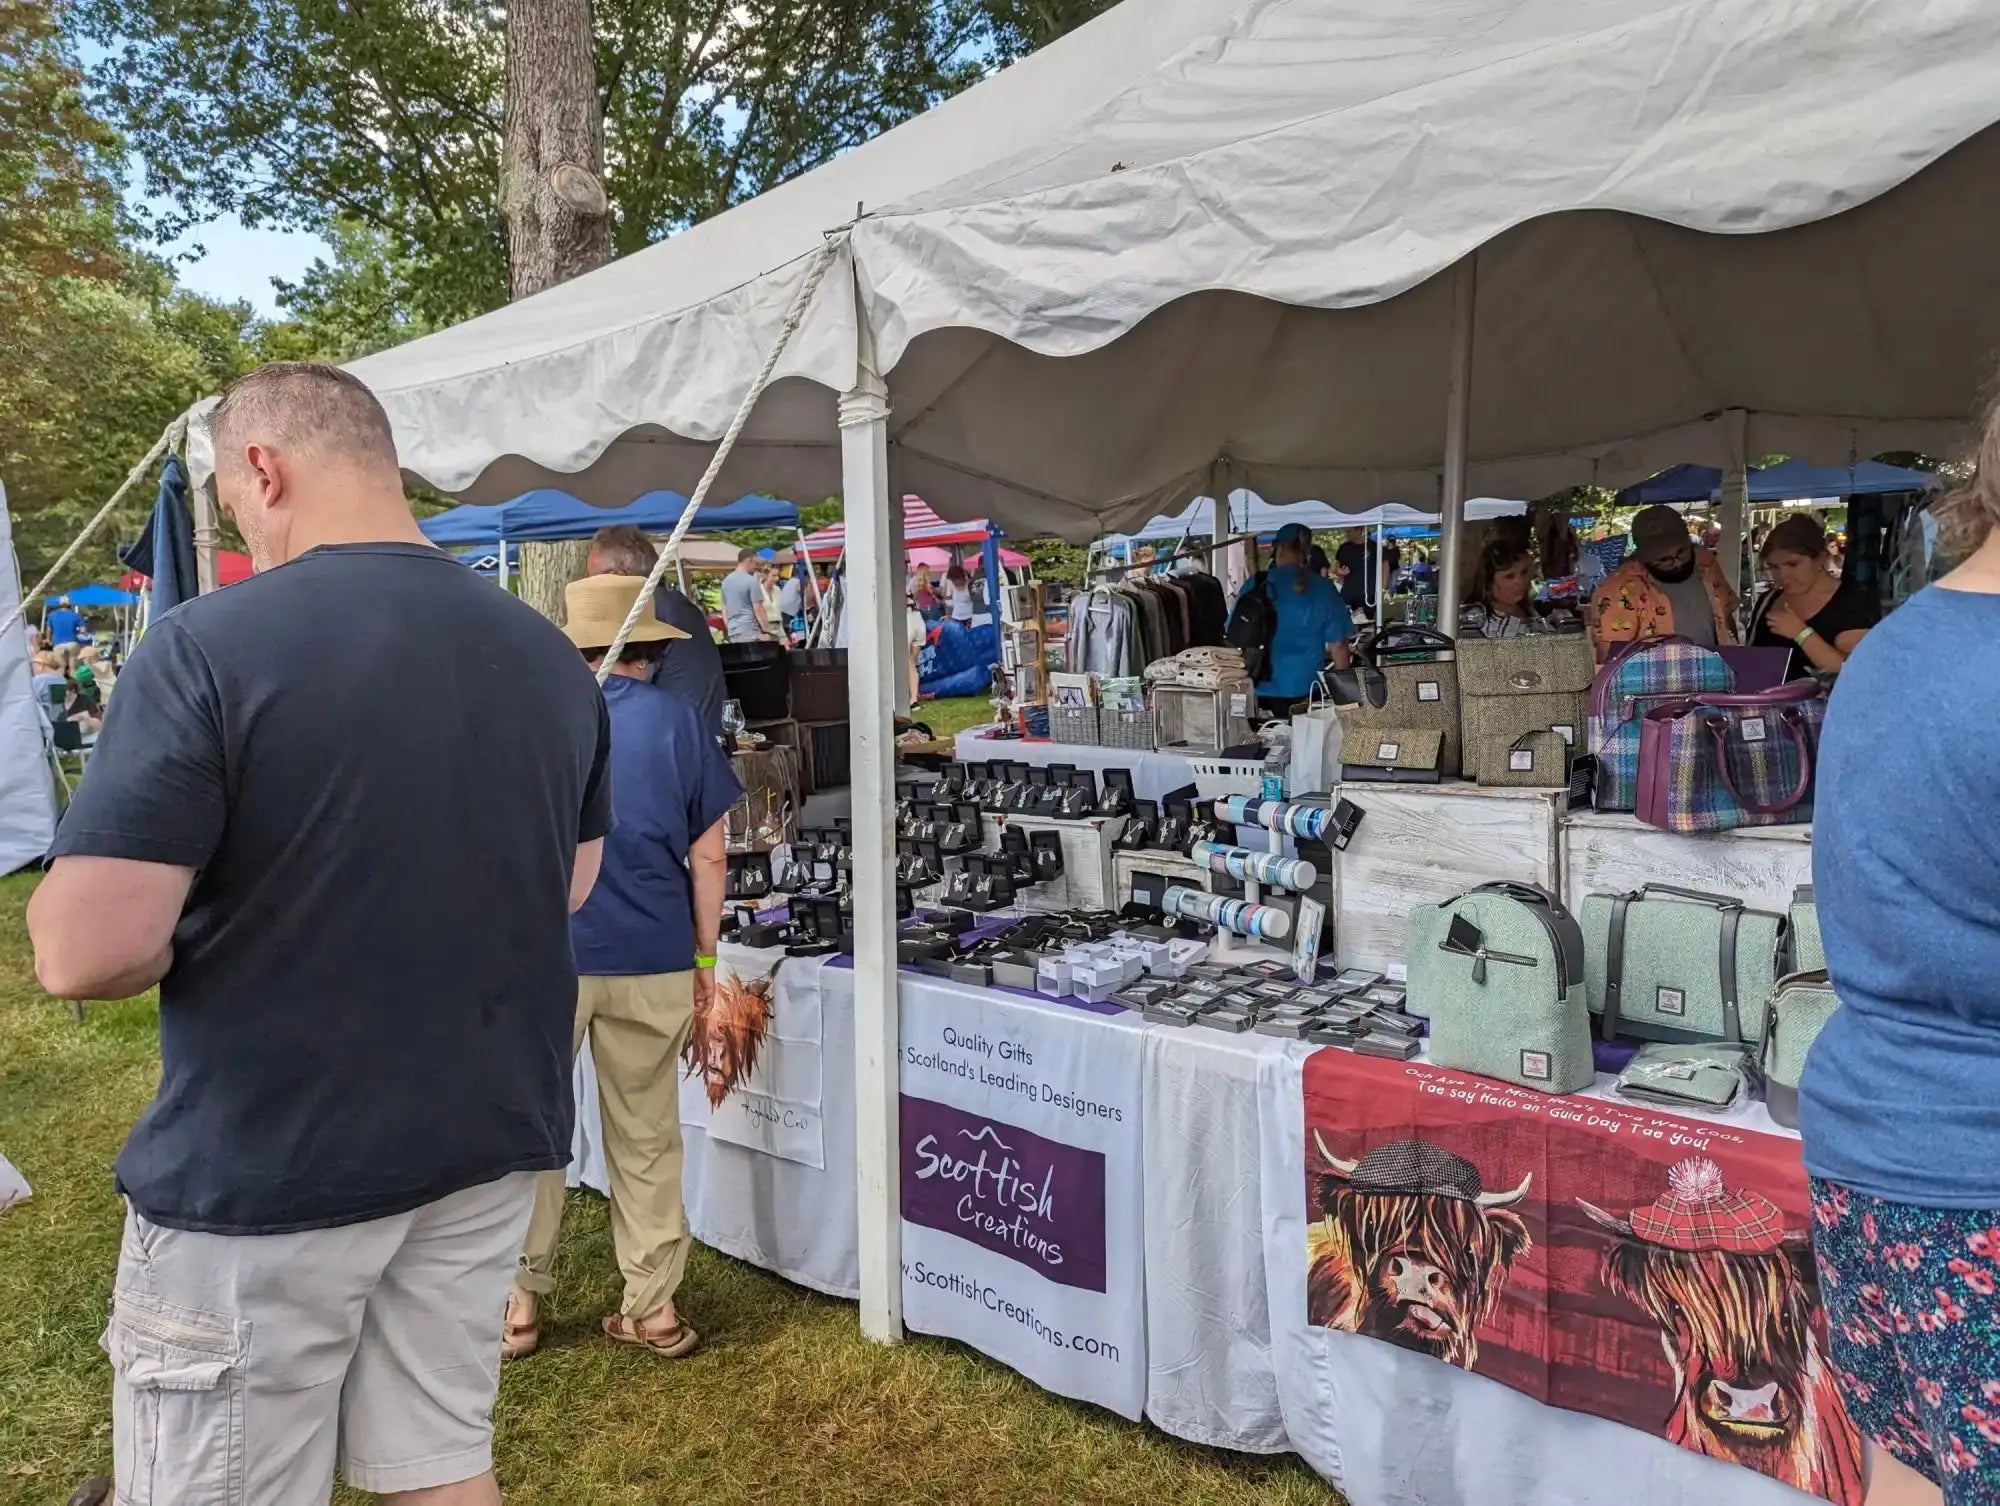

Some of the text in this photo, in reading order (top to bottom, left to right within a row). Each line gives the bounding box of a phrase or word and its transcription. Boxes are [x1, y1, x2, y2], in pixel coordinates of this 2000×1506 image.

[943, 1027, 1033, 1066] Quality Gifts
[907, 1047, 1123, 1122] Scotland's Leading Designers
[1405, 1068, 1433, 1079] Och
[1505, 1088, 1541, 1102] Moo,
[1547, 1097, 1594, 1112] Here's
[1650, 1119, 1689, 1131] Wee
[1696, 1128, 1744, 1144] Coos,
[1418, 1080, 1445, 1095] Tae
[1449, 1088, 1476, 1104] say
[1480, 1092, 1517, 1108] Hello
[1587, 1115, 1621, 1133] Day
[1630, 1123, 1664, 1139] Tae
[915, 1134, 1054, 1223] Scottish
[956, 1194, 1064, 1265] Creations
